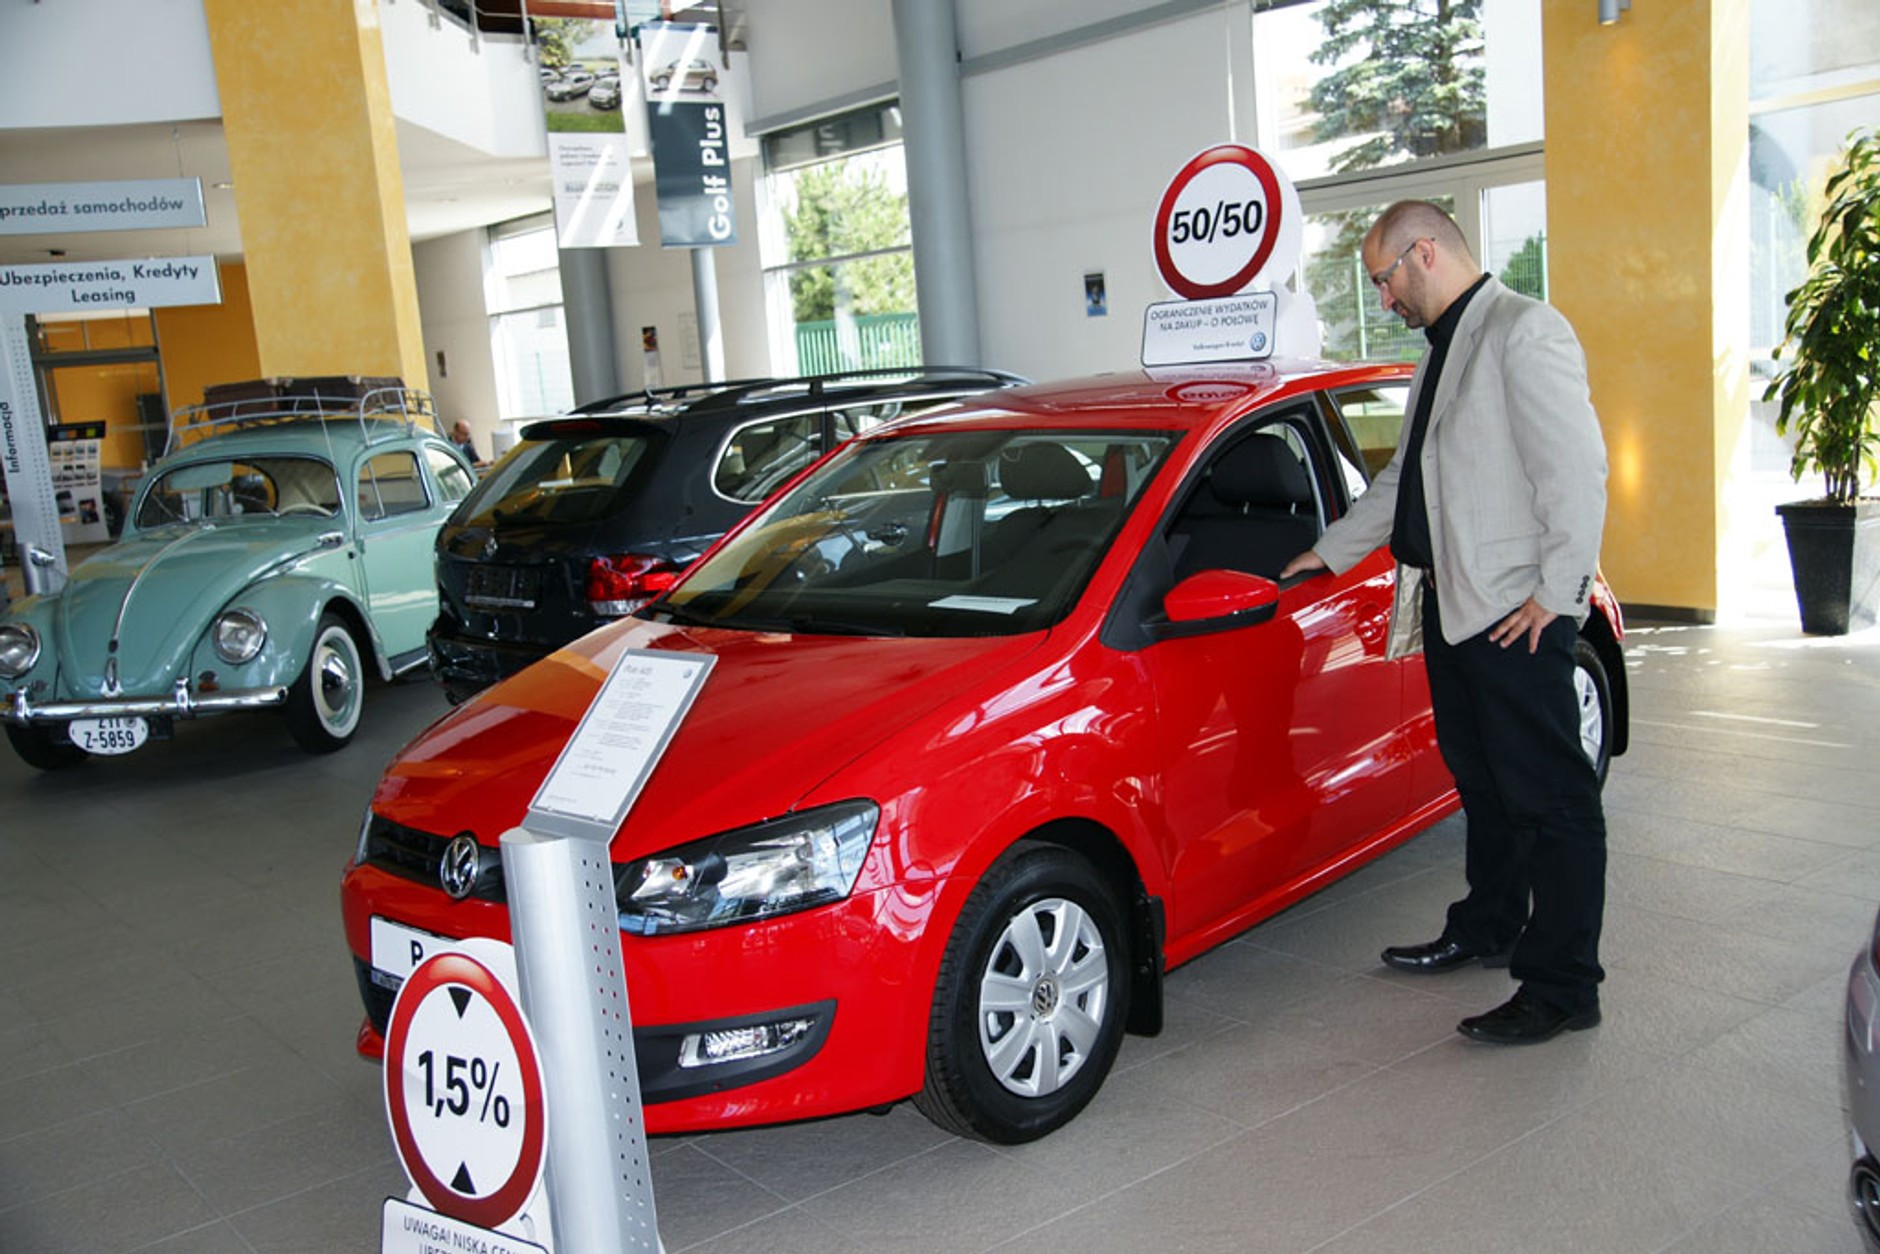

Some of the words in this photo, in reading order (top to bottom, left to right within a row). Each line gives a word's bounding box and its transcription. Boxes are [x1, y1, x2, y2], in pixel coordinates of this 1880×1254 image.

[699, 107, 725, 166] Plus
[73, 197, 183, 214] samochodów
[705, 175, 731, 240] Golf
[1172, 200, 1263, 244] 50/50
[0, 266, 126, 287] Ubezpieczenia,
[133, 264, 199, 281] Kredyty
[72, 288, 136, 303] Leasing
[1151, 304, 1213, 321] OGRANICZENIE
[1215, 300, 1268, 315] WYDATKÓW
[1160, 322, 1173, 331] NA
[1175, 318, 1202, 330] ZAKUP
[0, 402, 20, 473] Informacja
[84, 730, 135, 749] Z-5859
[418, 1050, 510, 1129] 1,5%
